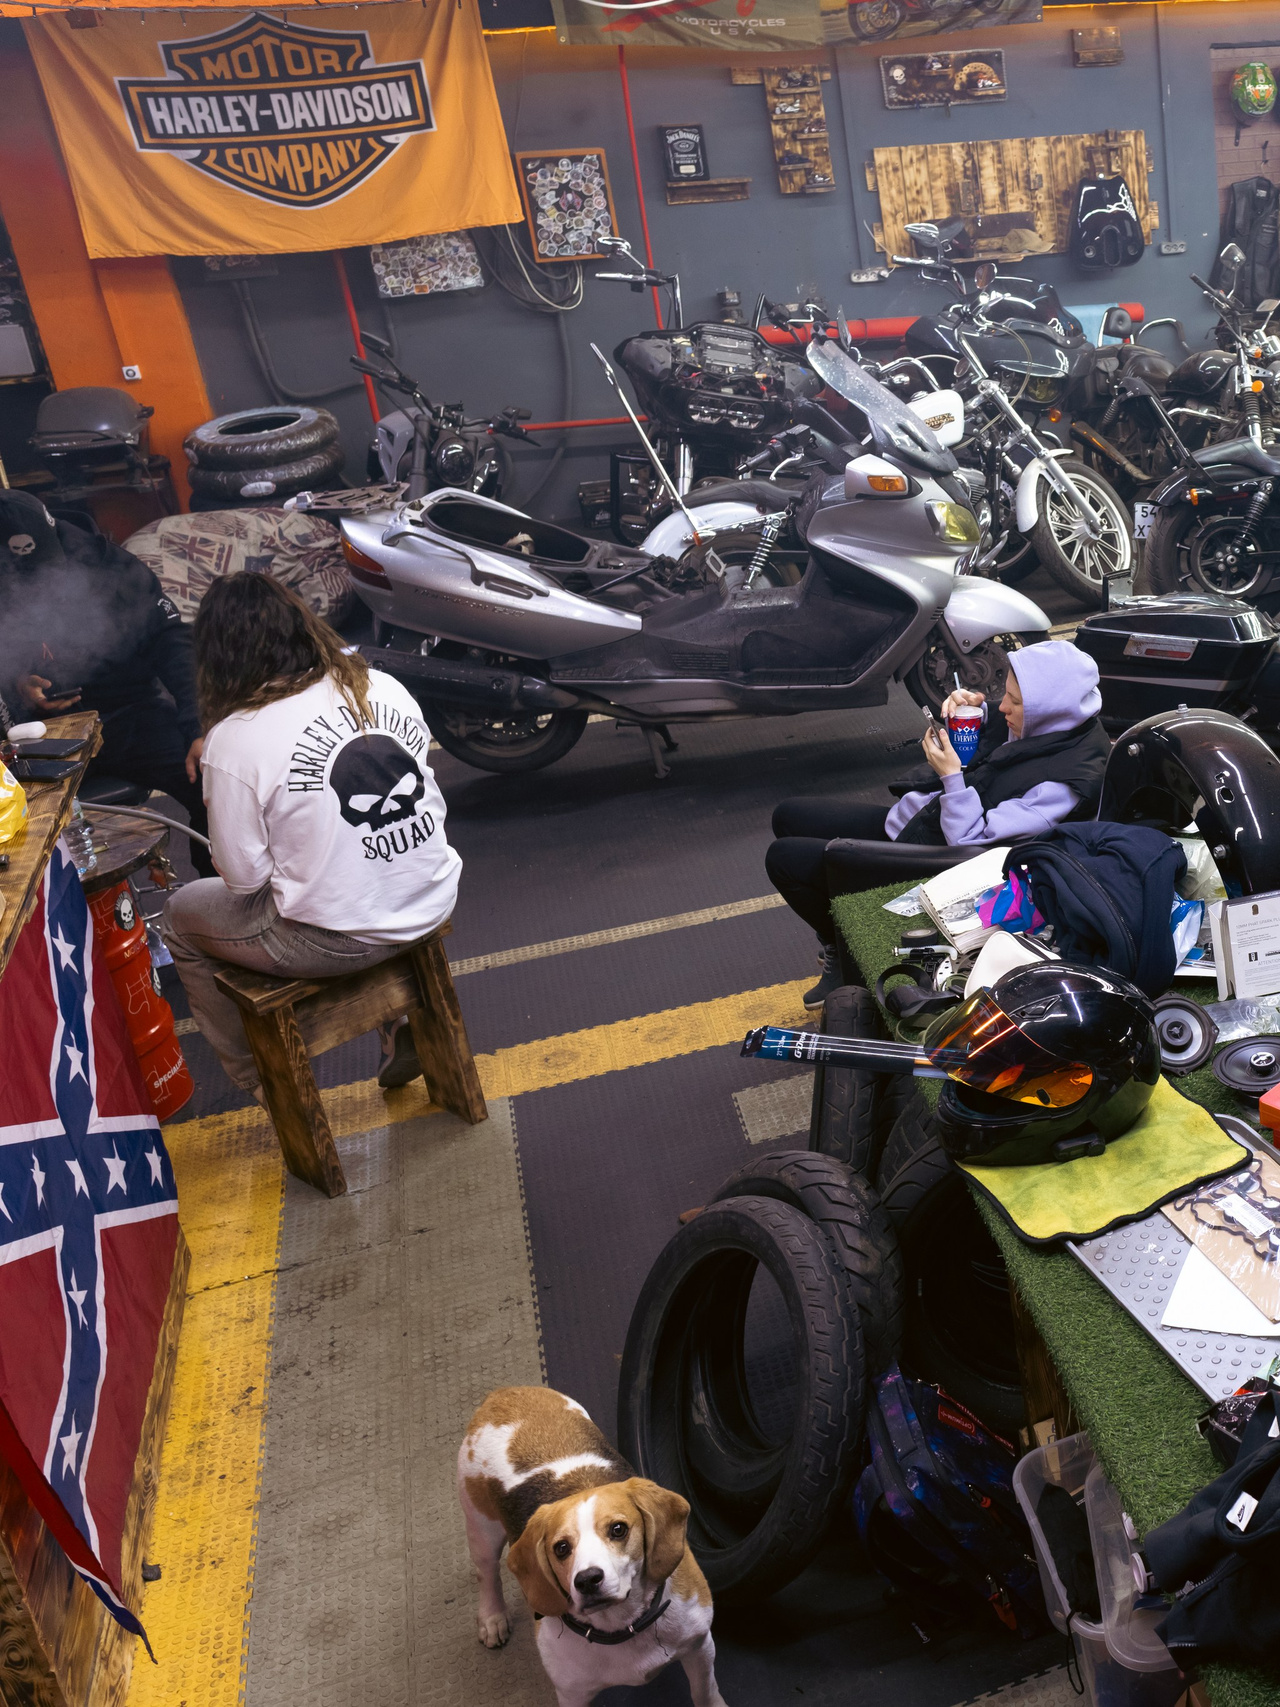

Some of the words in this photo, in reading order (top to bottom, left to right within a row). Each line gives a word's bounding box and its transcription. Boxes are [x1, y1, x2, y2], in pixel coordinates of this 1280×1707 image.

[675, 16, 786, 27] MOTORCYCLES
[200, 34, 342, 81] MOTOR
[147, 81, 413, 135] HARLEY-DAVIDSON
[224, 138, 363, 193] COMPANY
[1141, 506, 1157, 518] 54
[953, 733, 979, 742] EVERVESS
[361, 811, 435, 862] SQUAD
